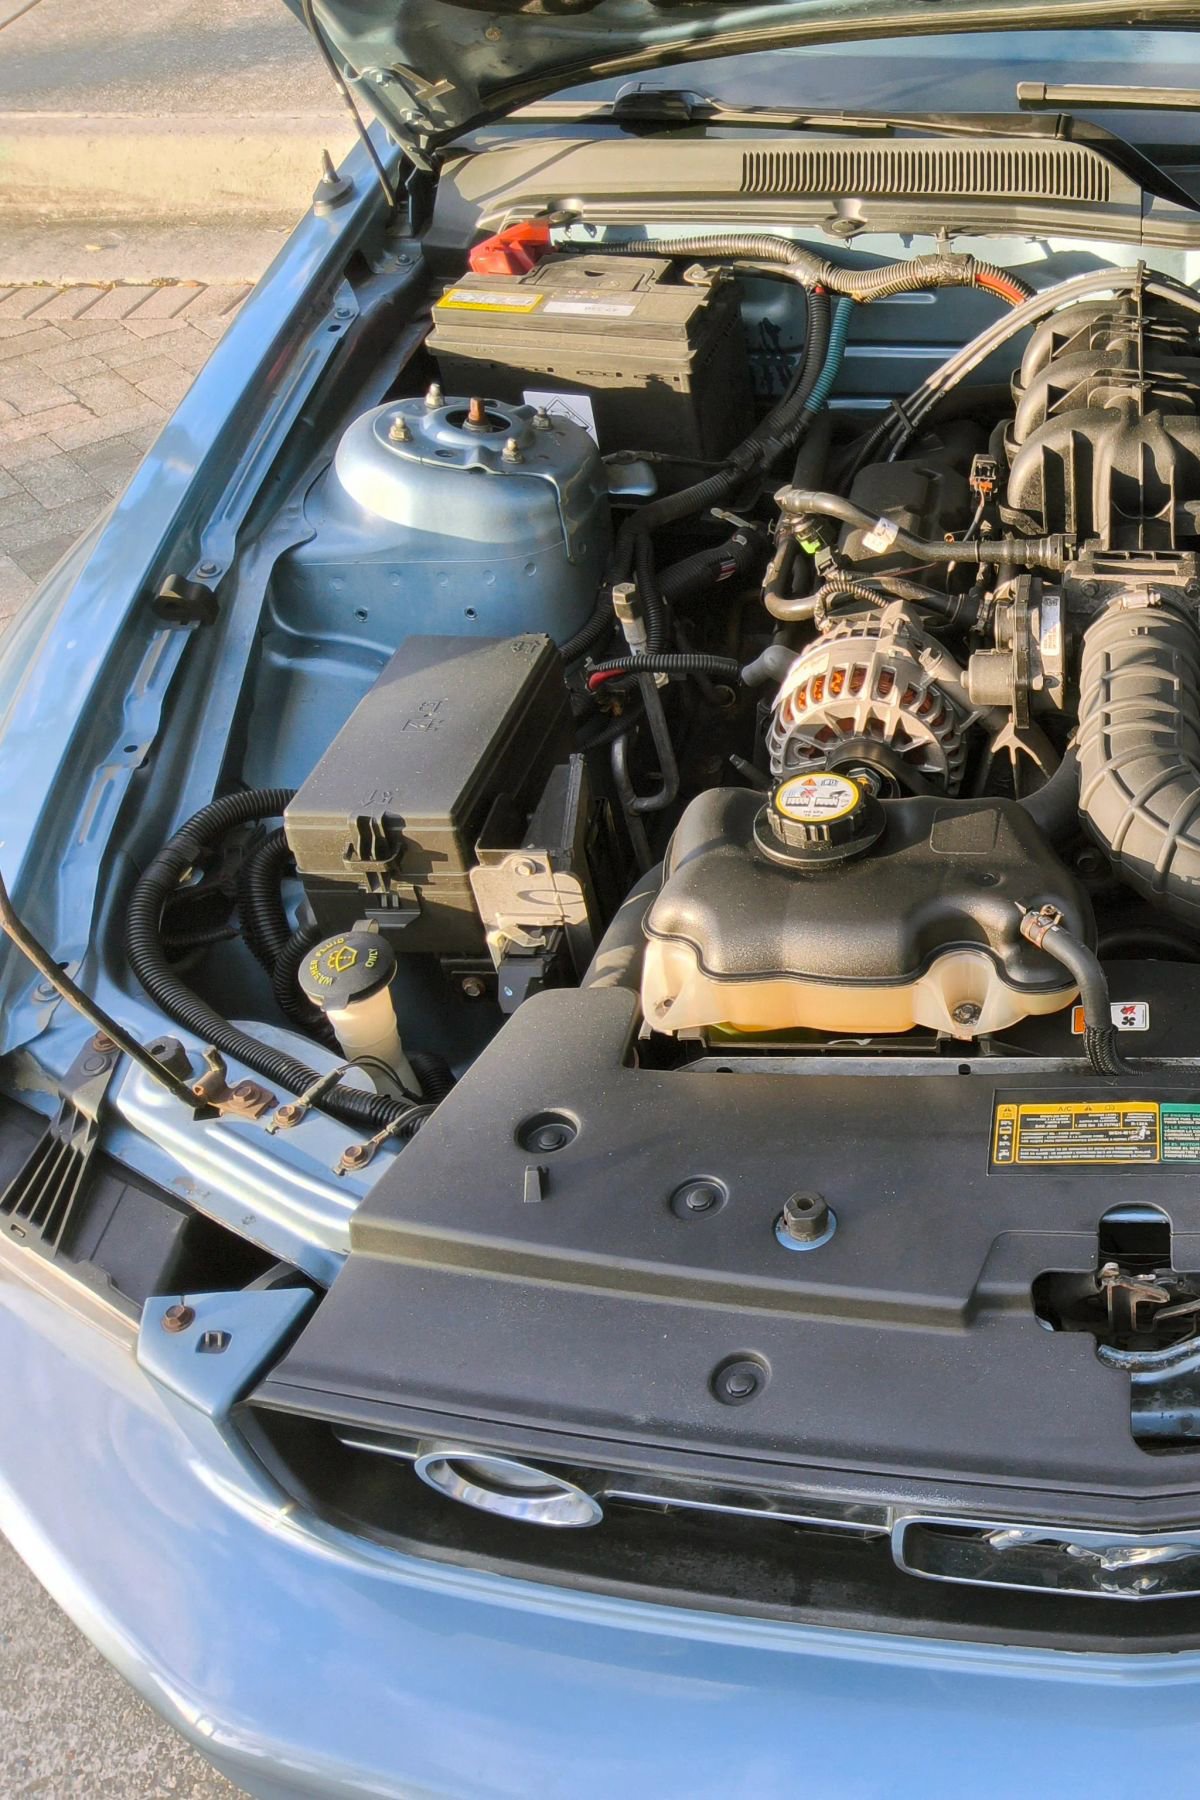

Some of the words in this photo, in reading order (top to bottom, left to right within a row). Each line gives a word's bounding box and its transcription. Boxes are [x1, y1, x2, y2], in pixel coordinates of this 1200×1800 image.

[315, 937, 344, 957] FLUID
[365, 948, 378, 968] ONLY
[310, 959, 334, 986] WASHER
